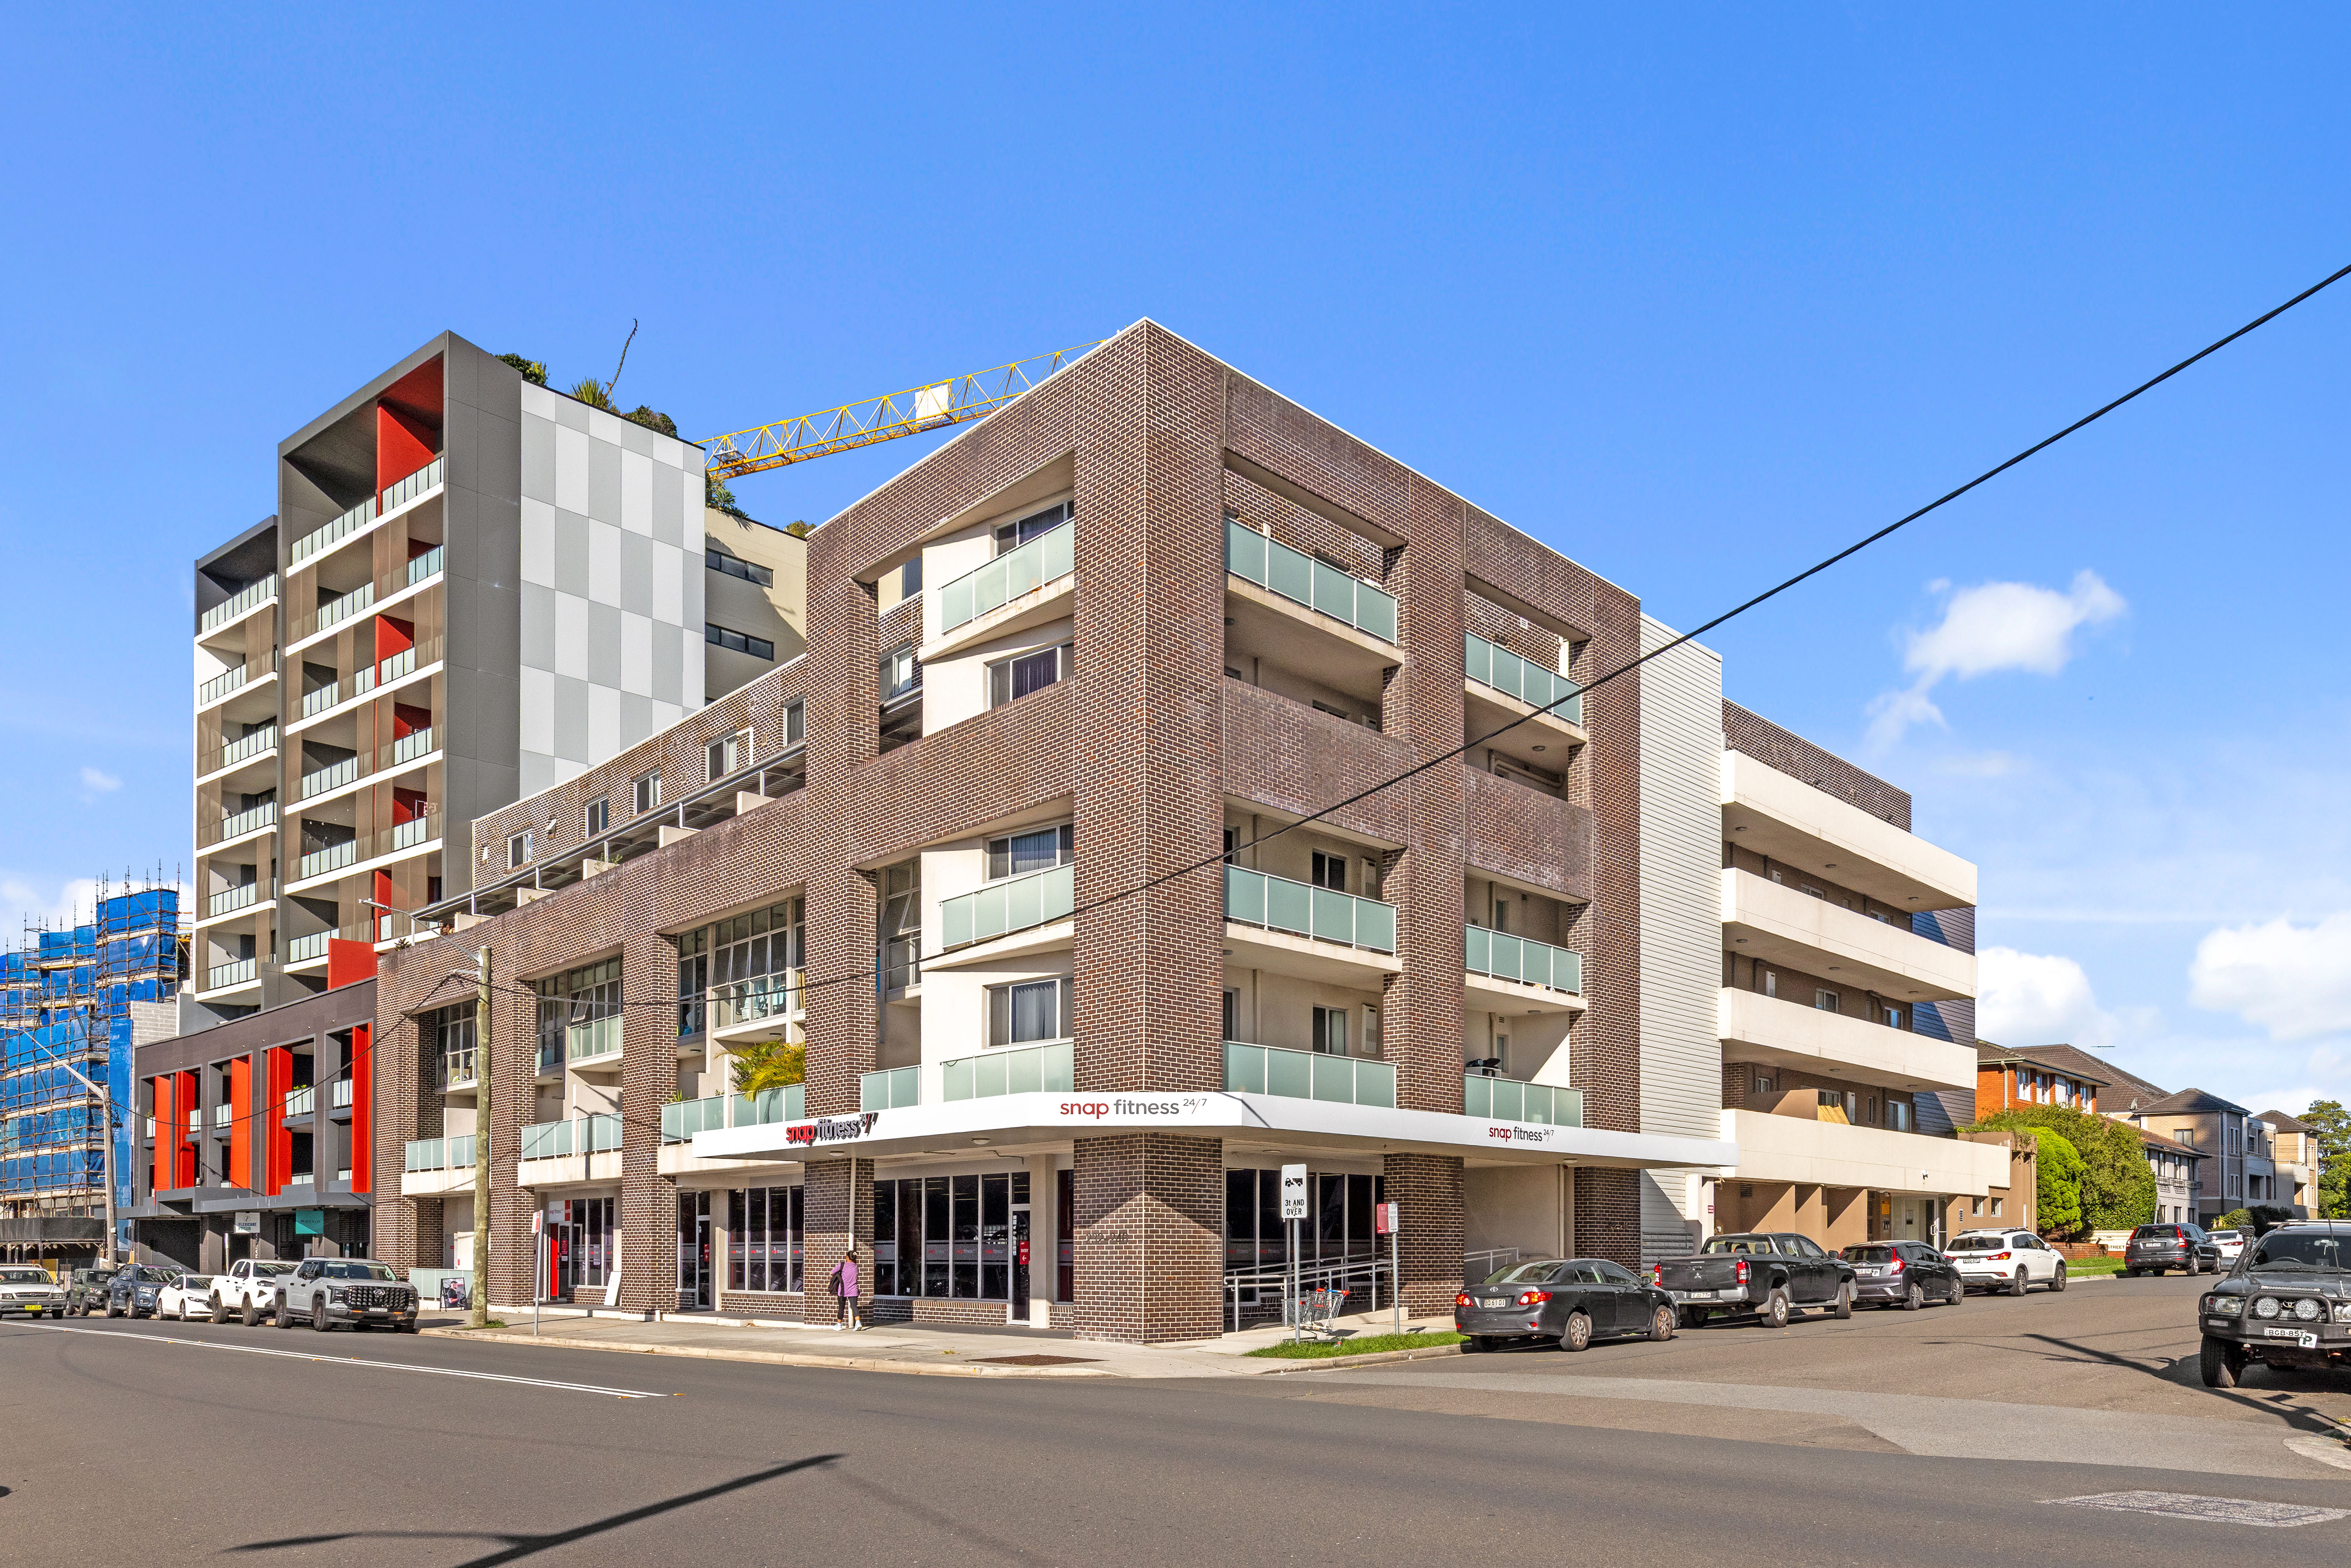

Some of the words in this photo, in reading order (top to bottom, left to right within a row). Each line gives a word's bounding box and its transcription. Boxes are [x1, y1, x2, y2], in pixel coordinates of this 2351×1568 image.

[1060, 1103, 1109, 1119] snap
[1114, 1099, 1179, 1114] fitness
[1183, 1099, 1207, 1114] 24/7
[786, 1125, 814, 1145] snap
[817, 1119, 857, 1137] fitness
[859, 1112, 875, 1133] 24/7
[1489, 1127, 1512, 1142] snap
[1513, 1126, 1542, 1142] fitness
[1543, 1129, 1554, 1142] 24/7
[2302, 1335, 2312, 1345] P
